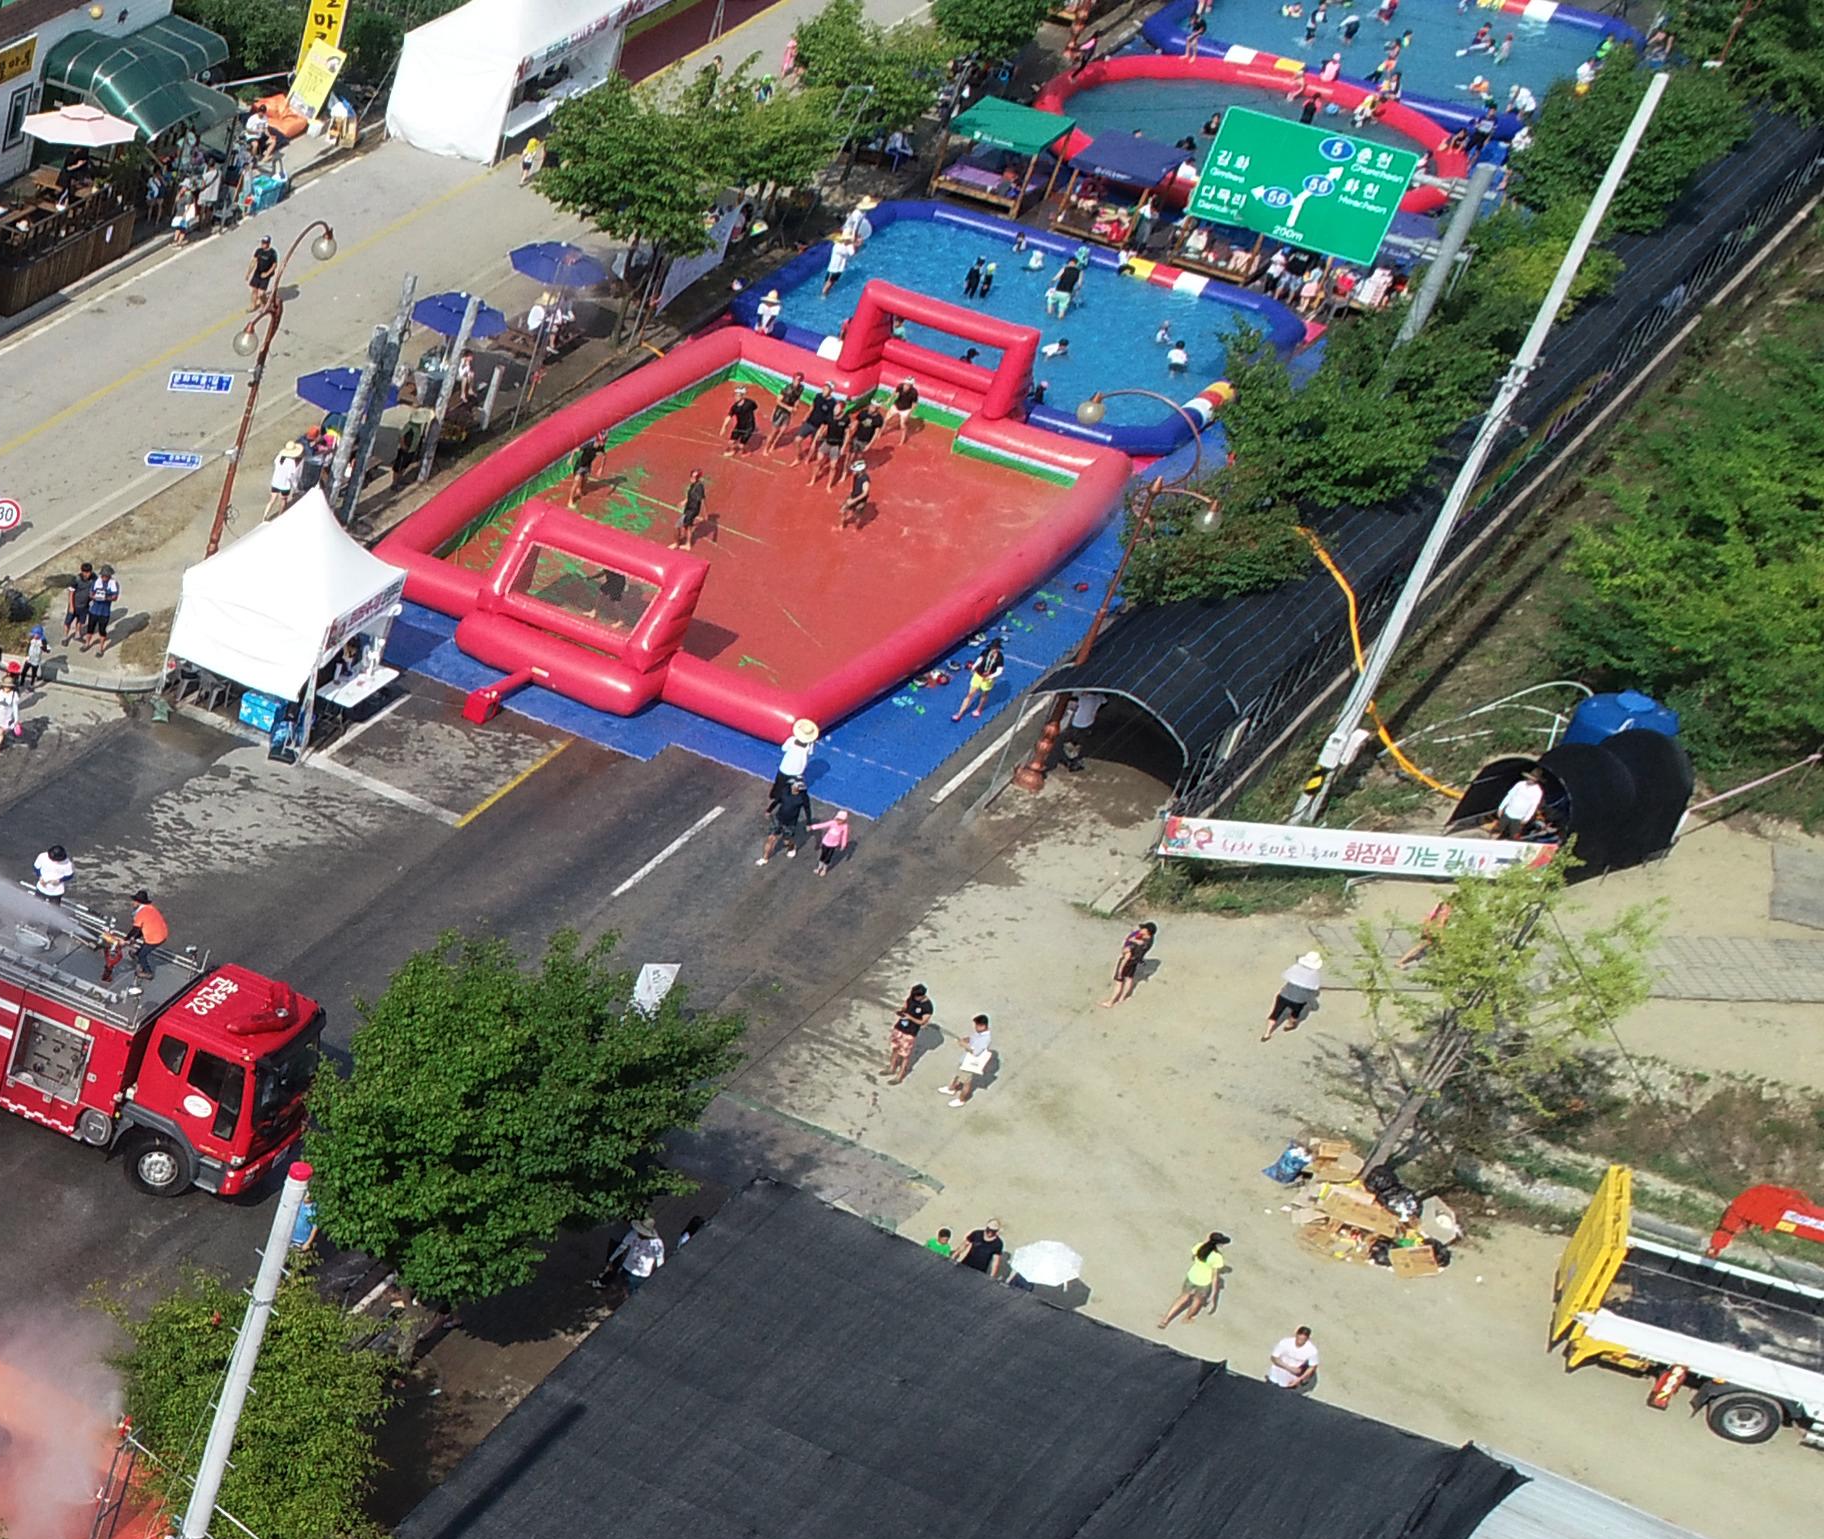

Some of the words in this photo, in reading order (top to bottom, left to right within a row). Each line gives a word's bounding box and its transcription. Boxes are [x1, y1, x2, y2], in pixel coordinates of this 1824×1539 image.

[1217, 150, 1250, 172] 김화
[1332, 142, 1344, 157] 5
[1356, 147, 1394, 170] 춘천
[1200, 184, 1248, 210] 다목리
[1342, 177, 1380, 201] 화천
[1273, 225, 1304, 242] 200m
[1342, 842, 1400, 866] 화장실
[1403, 846, 1440, 868] 가는
[185, 977, 239, 1015] 춘천32
